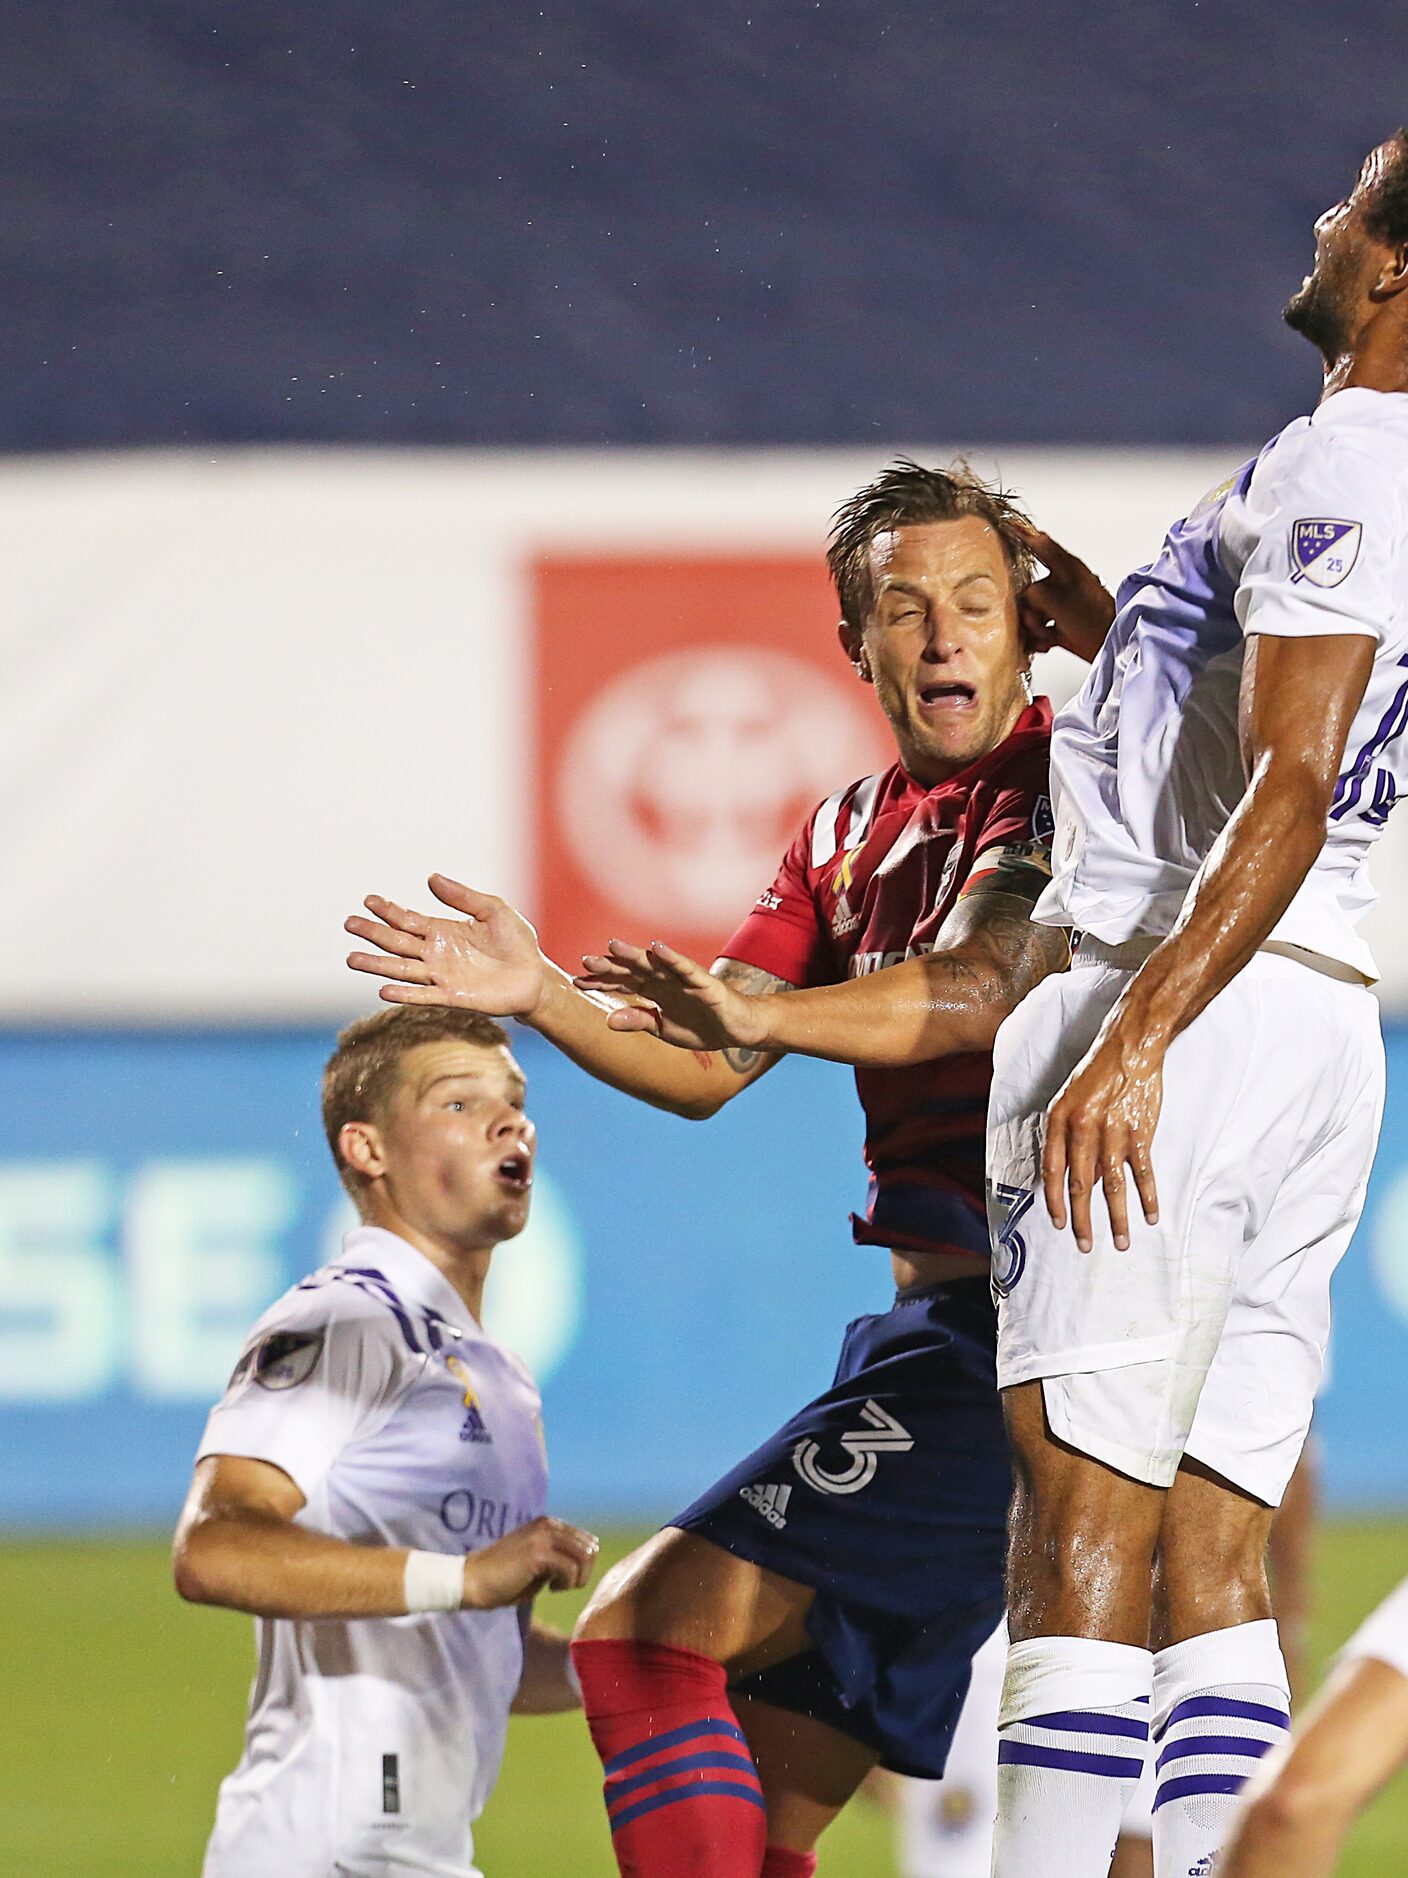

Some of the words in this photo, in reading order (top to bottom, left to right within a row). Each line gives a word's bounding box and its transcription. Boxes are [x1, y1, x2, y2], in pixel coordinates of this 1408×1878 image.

[1299, 524, 1336, 540] MLS
[1326, 557, 1344, 573] 25
[986, 1178, 1035, 1299] 3
[792, 1398, 916, 1495] 3
